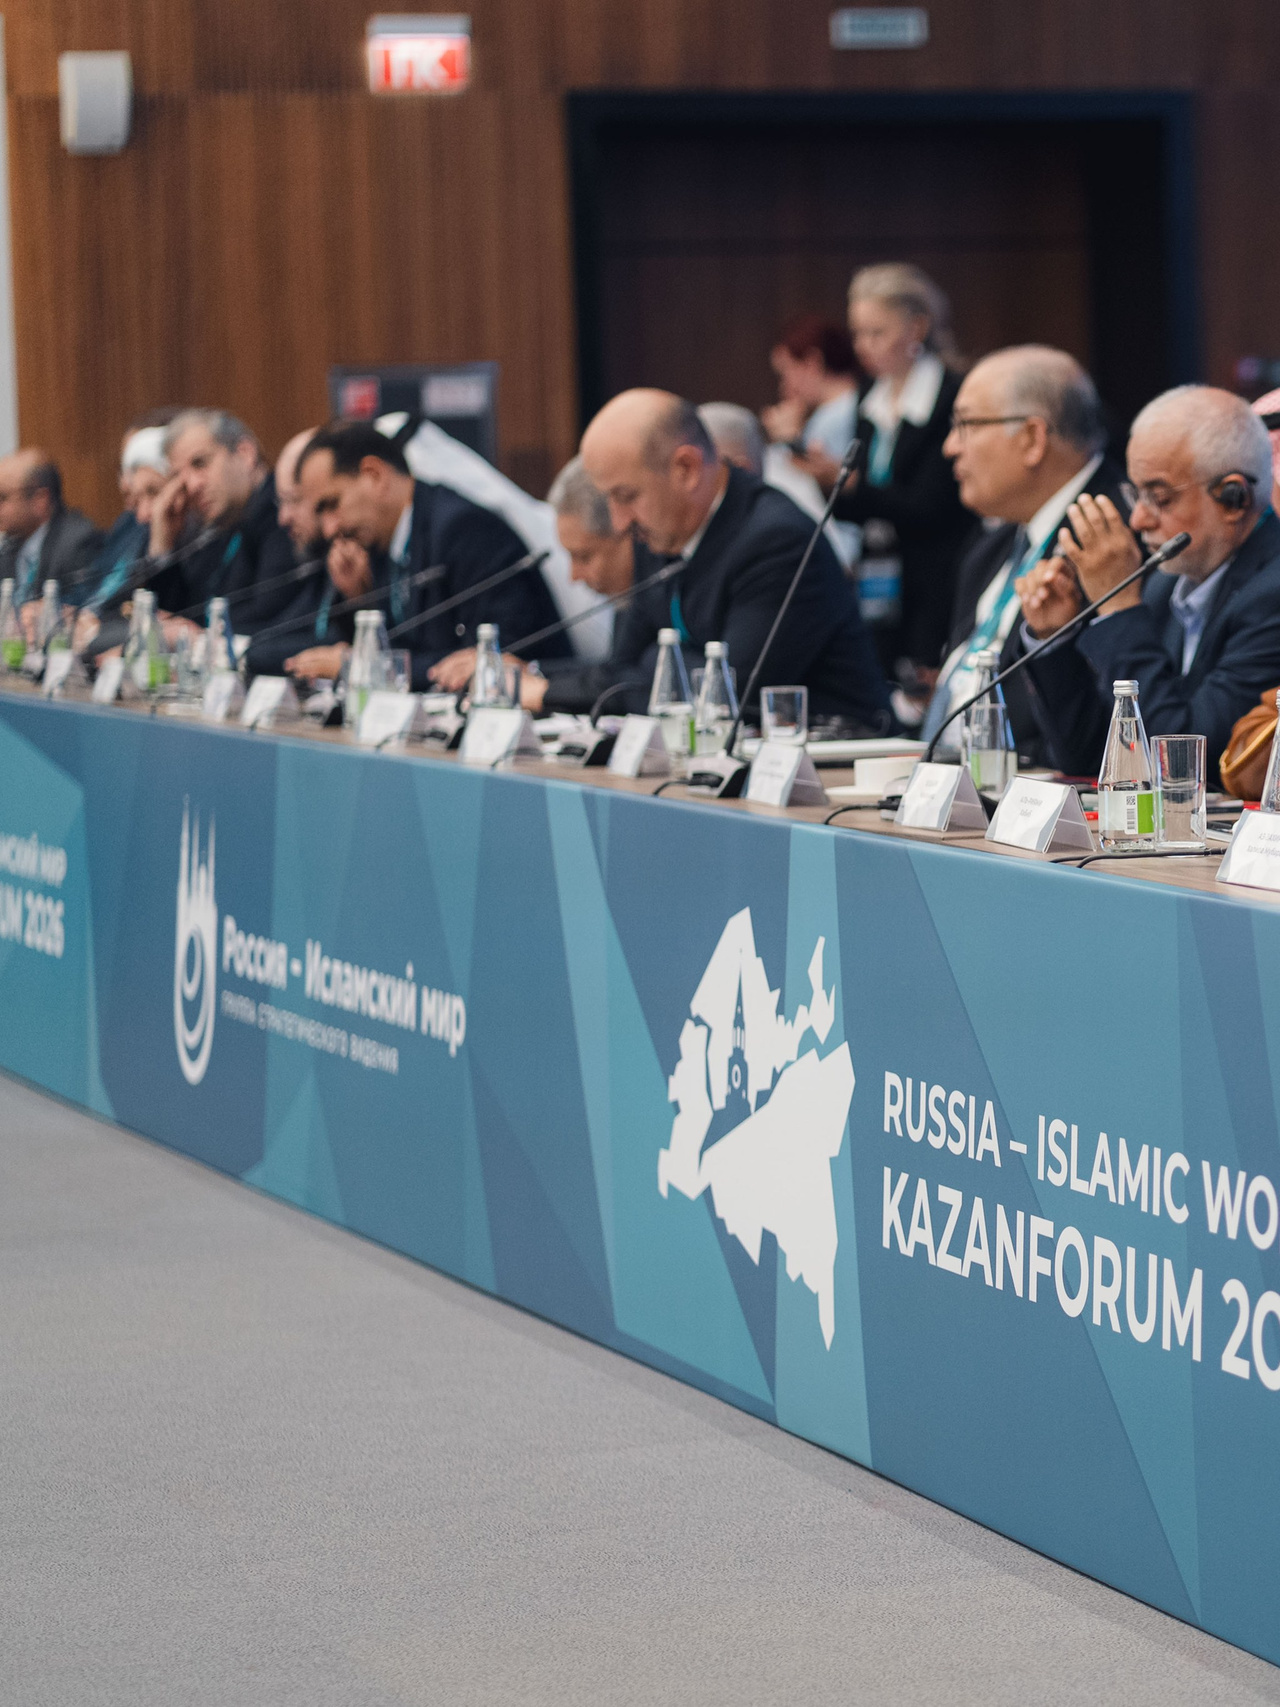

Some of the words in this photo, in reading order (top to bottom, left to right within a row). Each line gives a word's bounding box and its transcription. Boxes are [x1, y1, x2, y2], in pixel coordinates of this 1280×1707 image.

[25, 889, 65, 959] 2026
[222, 914, 288, 991] Россия
[304, 938, 418, 1032] Исламский
[420, 985, 467, 1058] мир
[883, 1070, 1002, 1168] RUSSIA
[1037, 1114, 1191, 1224] ISLAMIC
[882, 1166, 1204, 1363] KAZANFORUM
